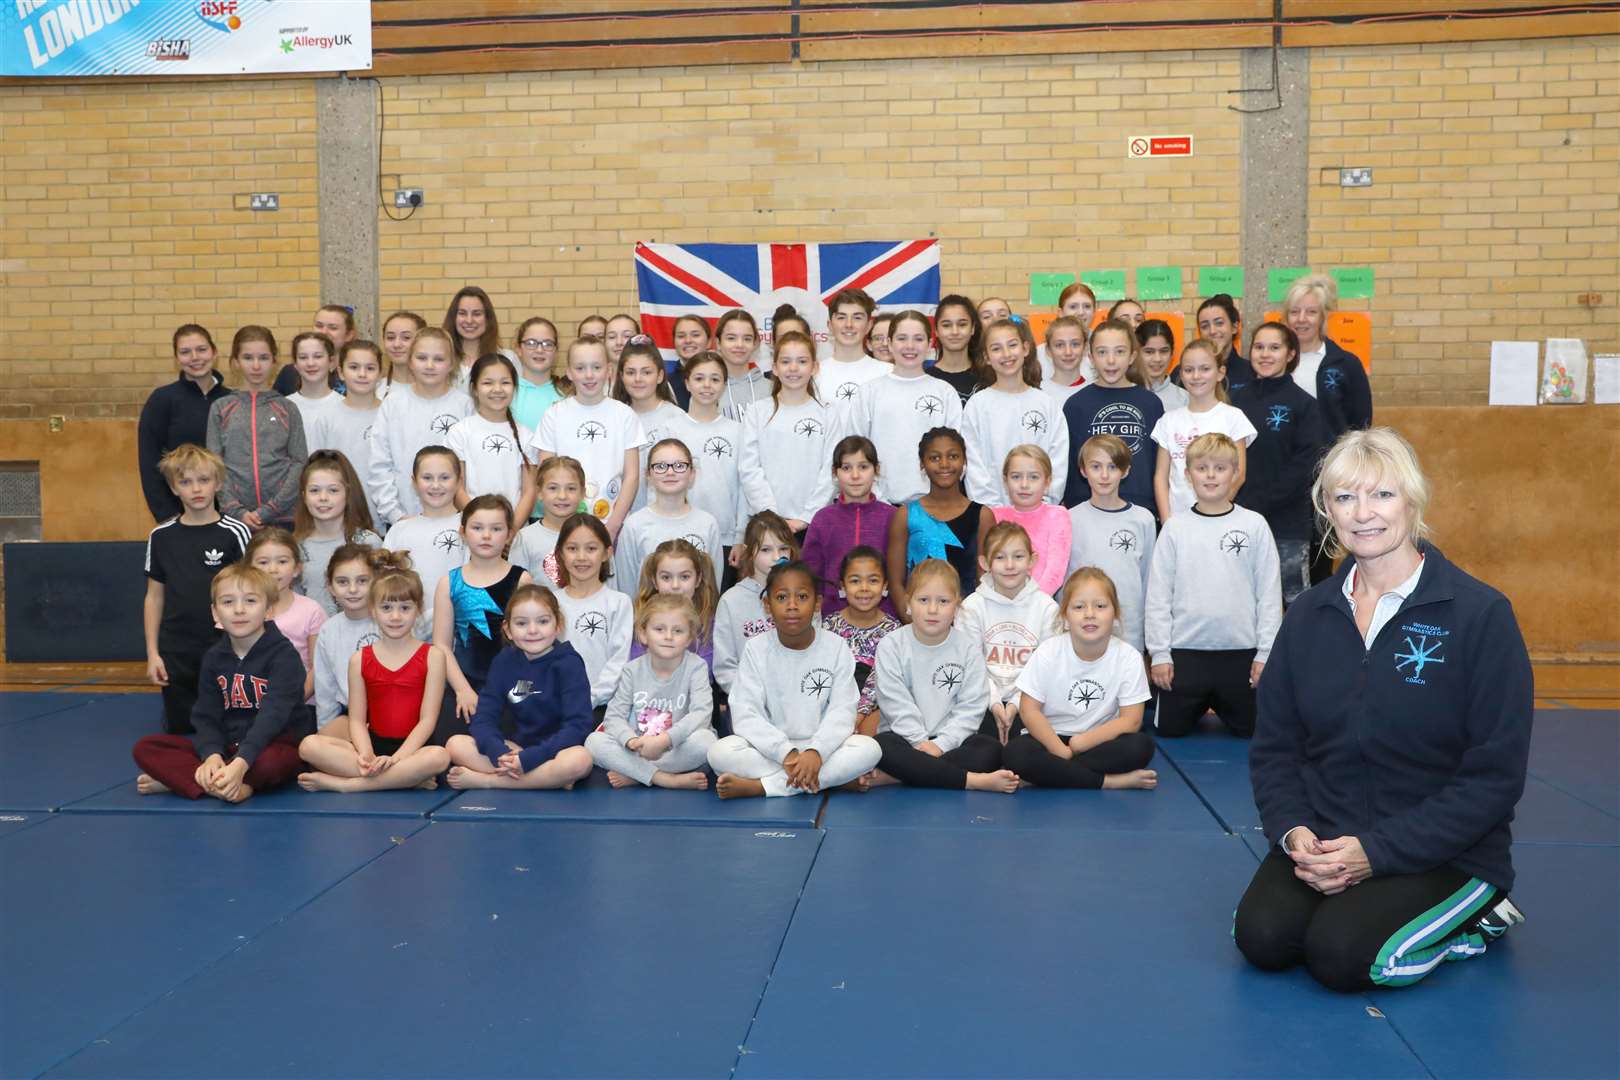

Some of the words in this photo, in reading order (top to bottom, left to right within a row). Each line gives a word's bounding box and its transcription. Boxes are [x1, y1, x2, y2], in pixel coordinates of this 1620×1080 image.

[293, 34, 352, 48] AllergyUK
[1092, 425, 1117, 435] HEY
[985, 645, 1037, 666] ANC
[1405, 677, 1426, 685] COACH
